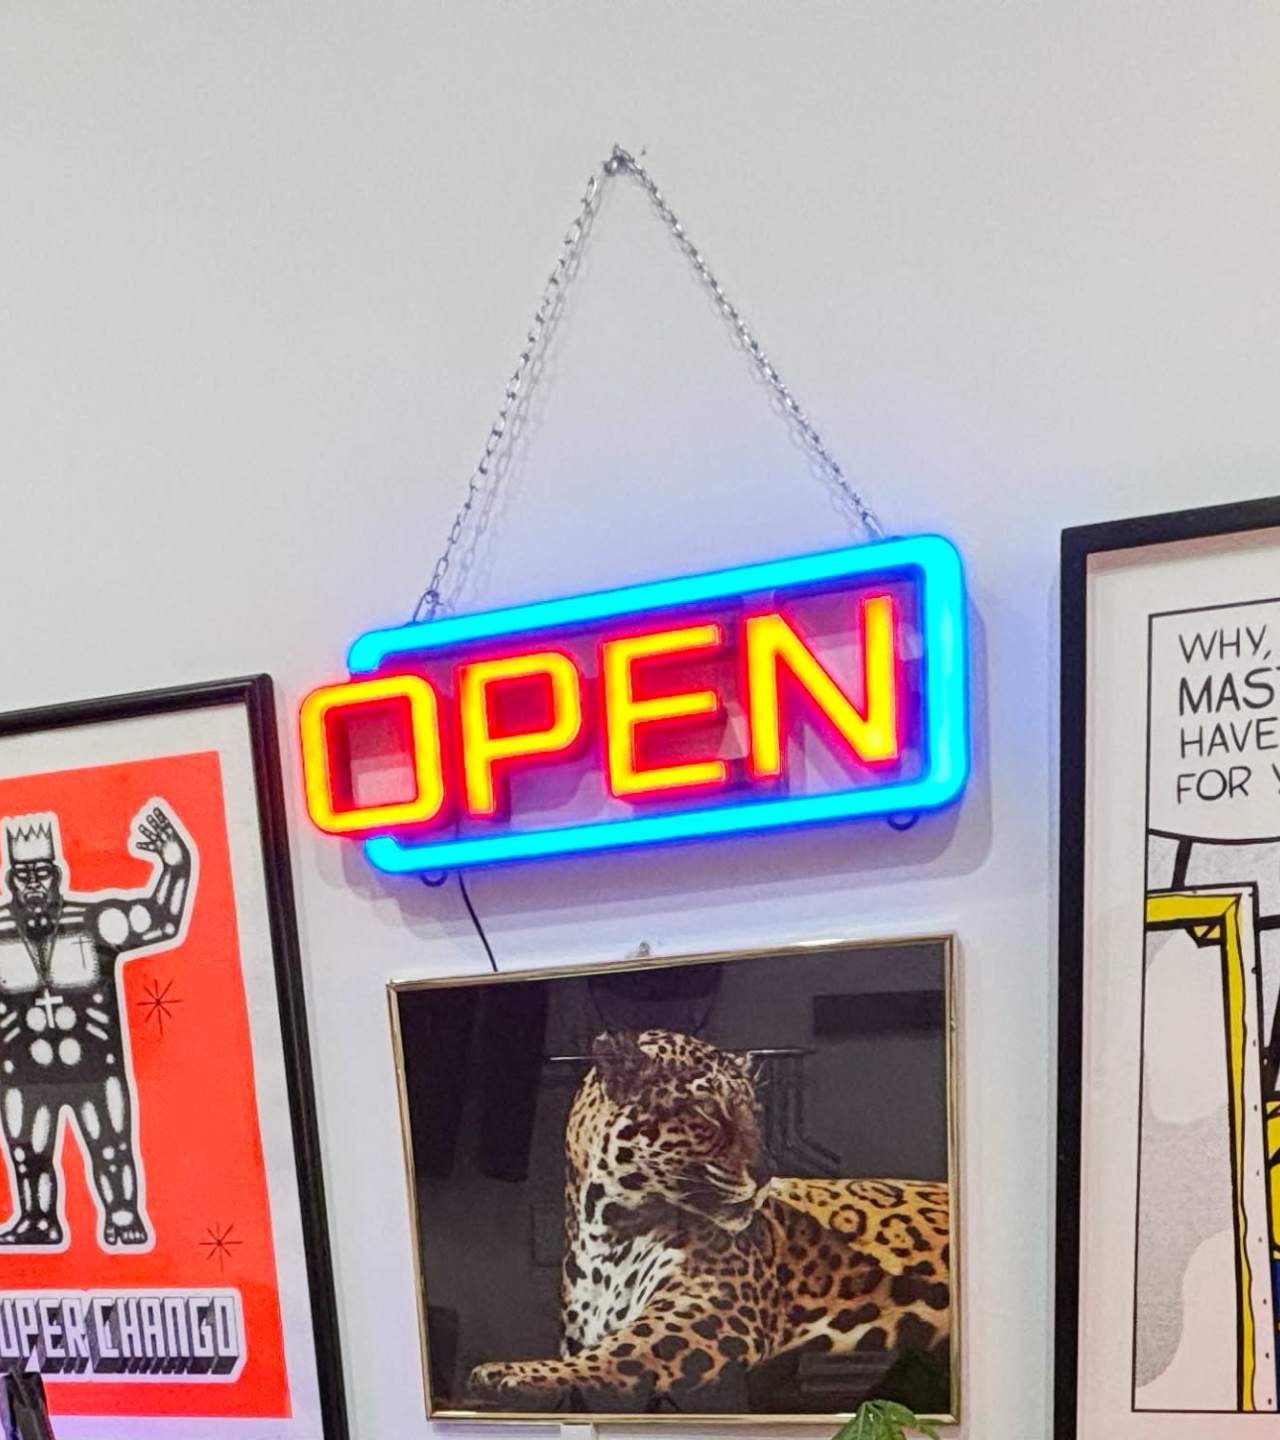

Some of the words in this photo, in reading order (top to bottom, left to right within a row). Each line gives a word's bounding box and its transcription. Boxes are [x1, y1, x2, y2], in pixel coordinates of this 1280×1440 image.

[1178, 624, 1273, 663] WHY,
[298, 593, 904, 836] OPEN
[1179, 716, 1279, 760] HAVE
[1176, 765, 1253, 804] FOR
[84, 1296, 240, 1375] CHANGO
